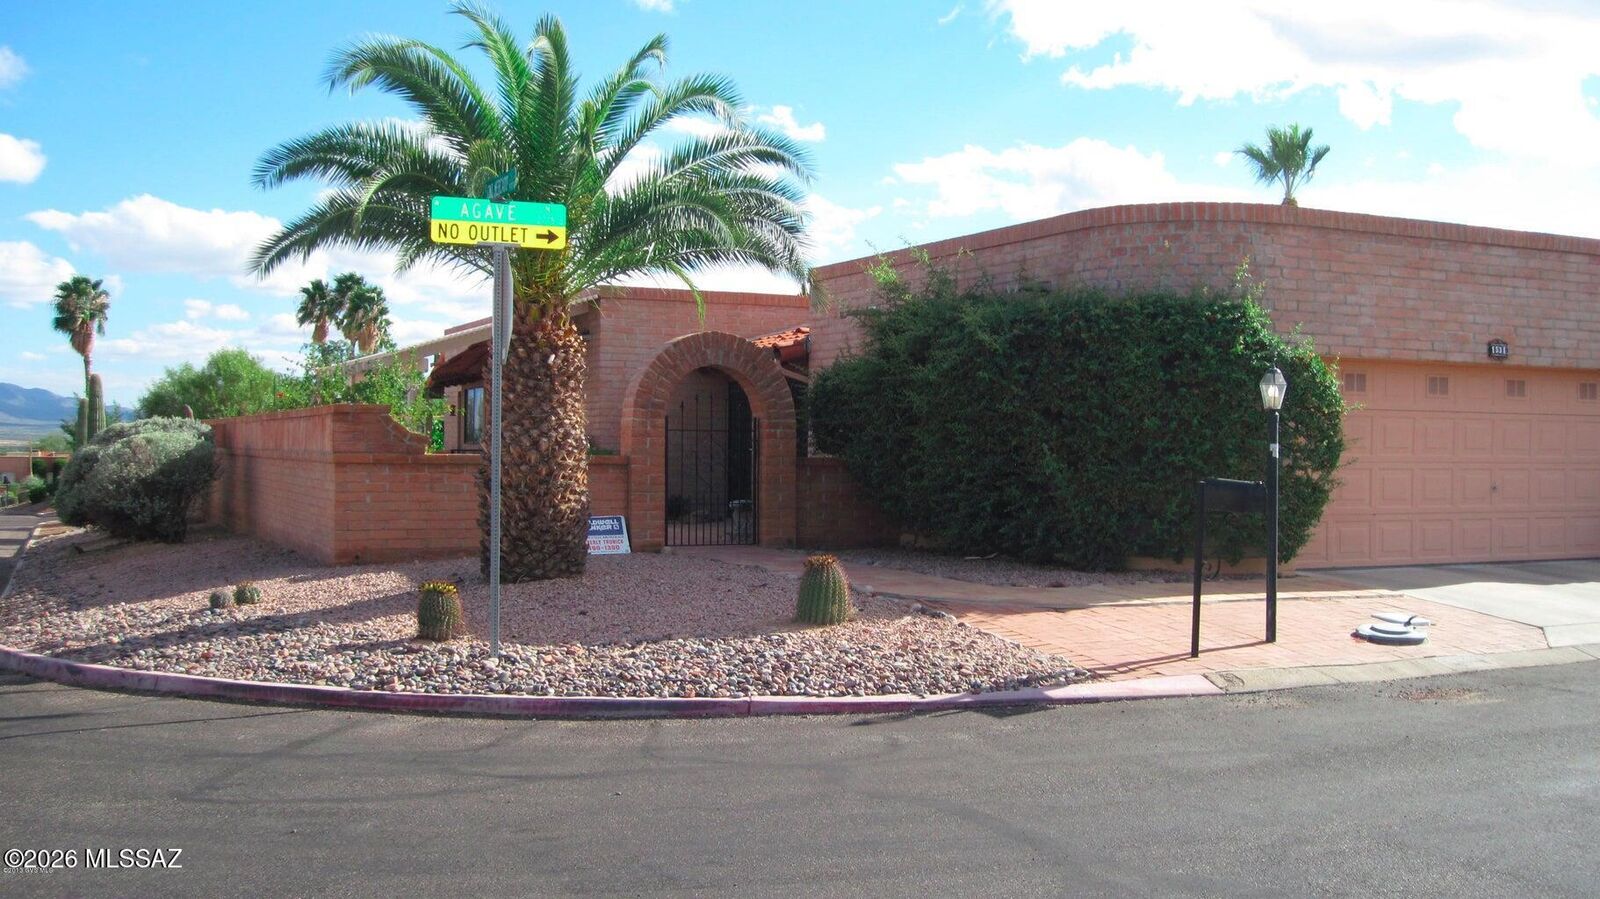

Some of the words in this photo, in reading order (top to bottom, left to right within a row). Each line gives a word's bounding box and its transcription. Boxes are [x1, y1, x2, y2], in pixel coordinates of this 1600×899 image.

[460, 203, 517, 221] AGAVE
[438, 223, 459, 239] NO
[468, 224, 528, 243] OUTLET
